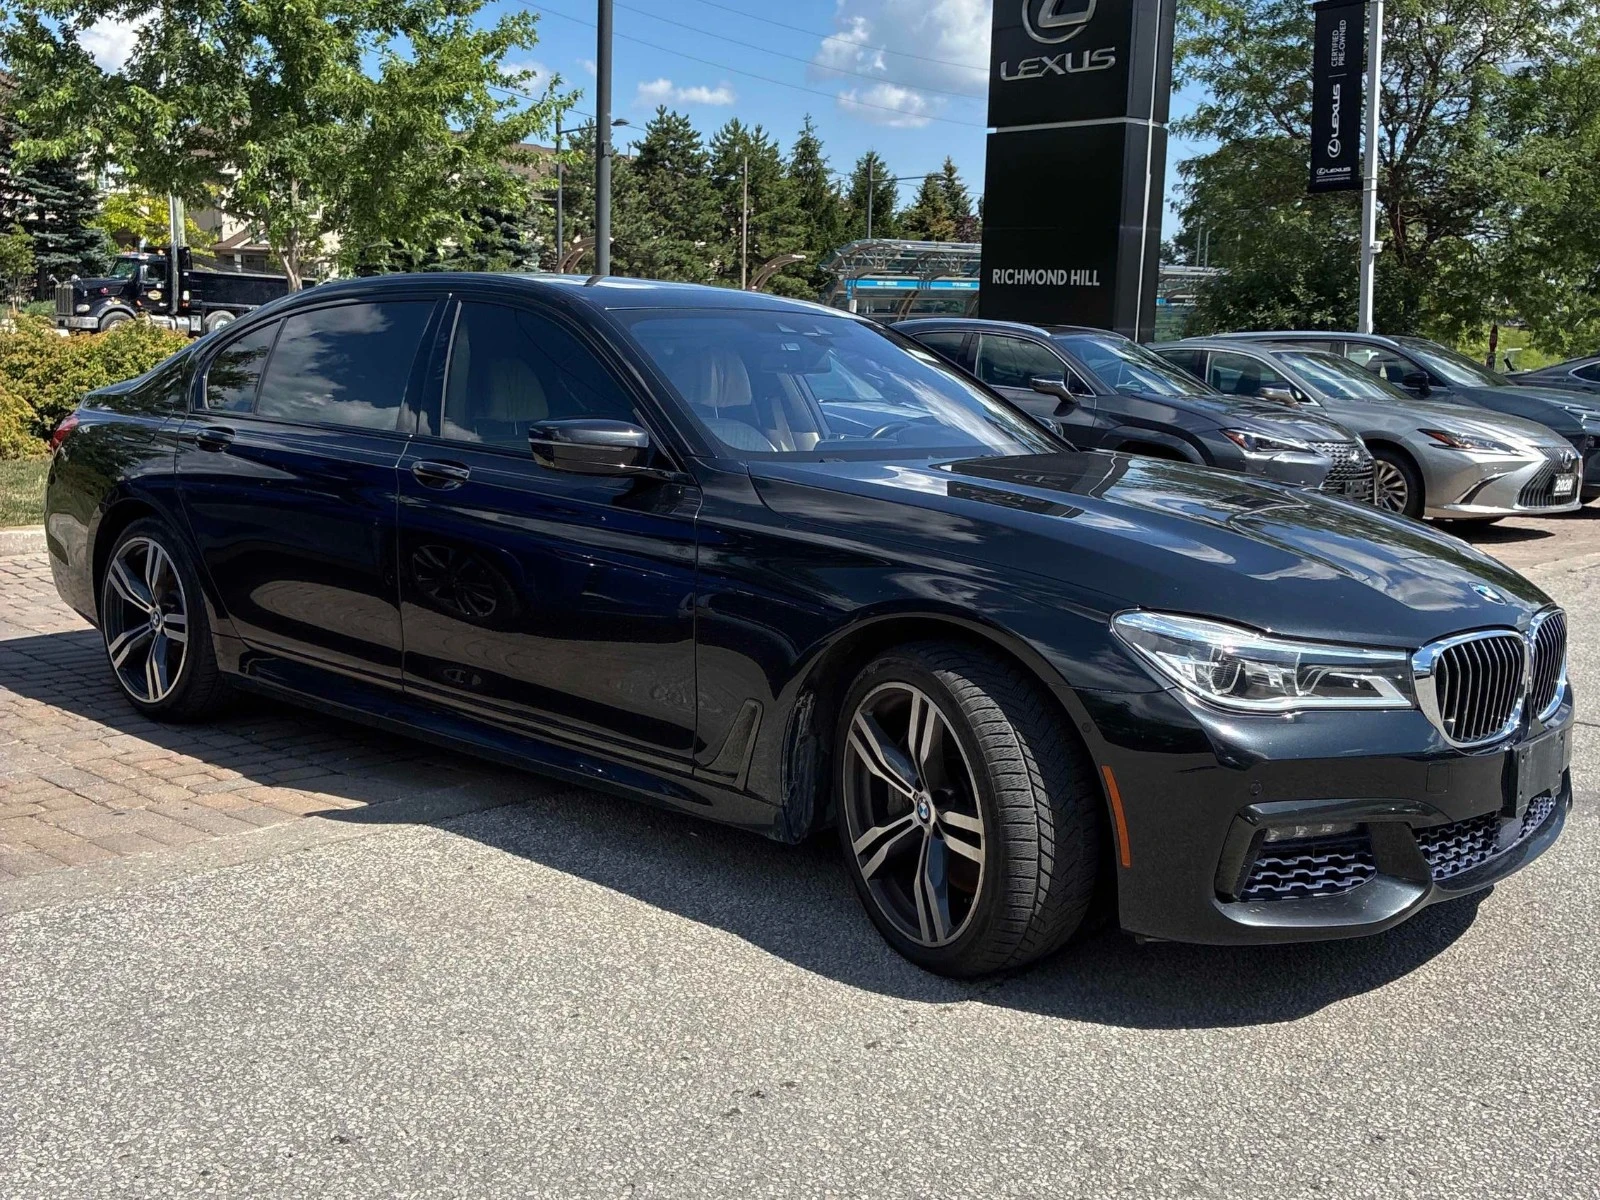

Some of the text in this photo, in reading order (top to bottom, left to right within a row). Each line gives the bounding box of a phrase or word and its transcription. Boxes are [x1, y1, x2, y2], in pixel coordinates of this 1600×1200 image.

[1331, 29, 1339, 67] CERTIFIED
[1338, 19, 1347, 67] PRE-OWNED
[1000, 46, 1116, 81] LEXUS
[1331, 83, 1341, 138] LEXUS
[1325, 166, 1351, 174] LEXUS
[992, 268, 1100, 287] RICHMOND HILL
[1555, 479, 1573, 491] 2020
